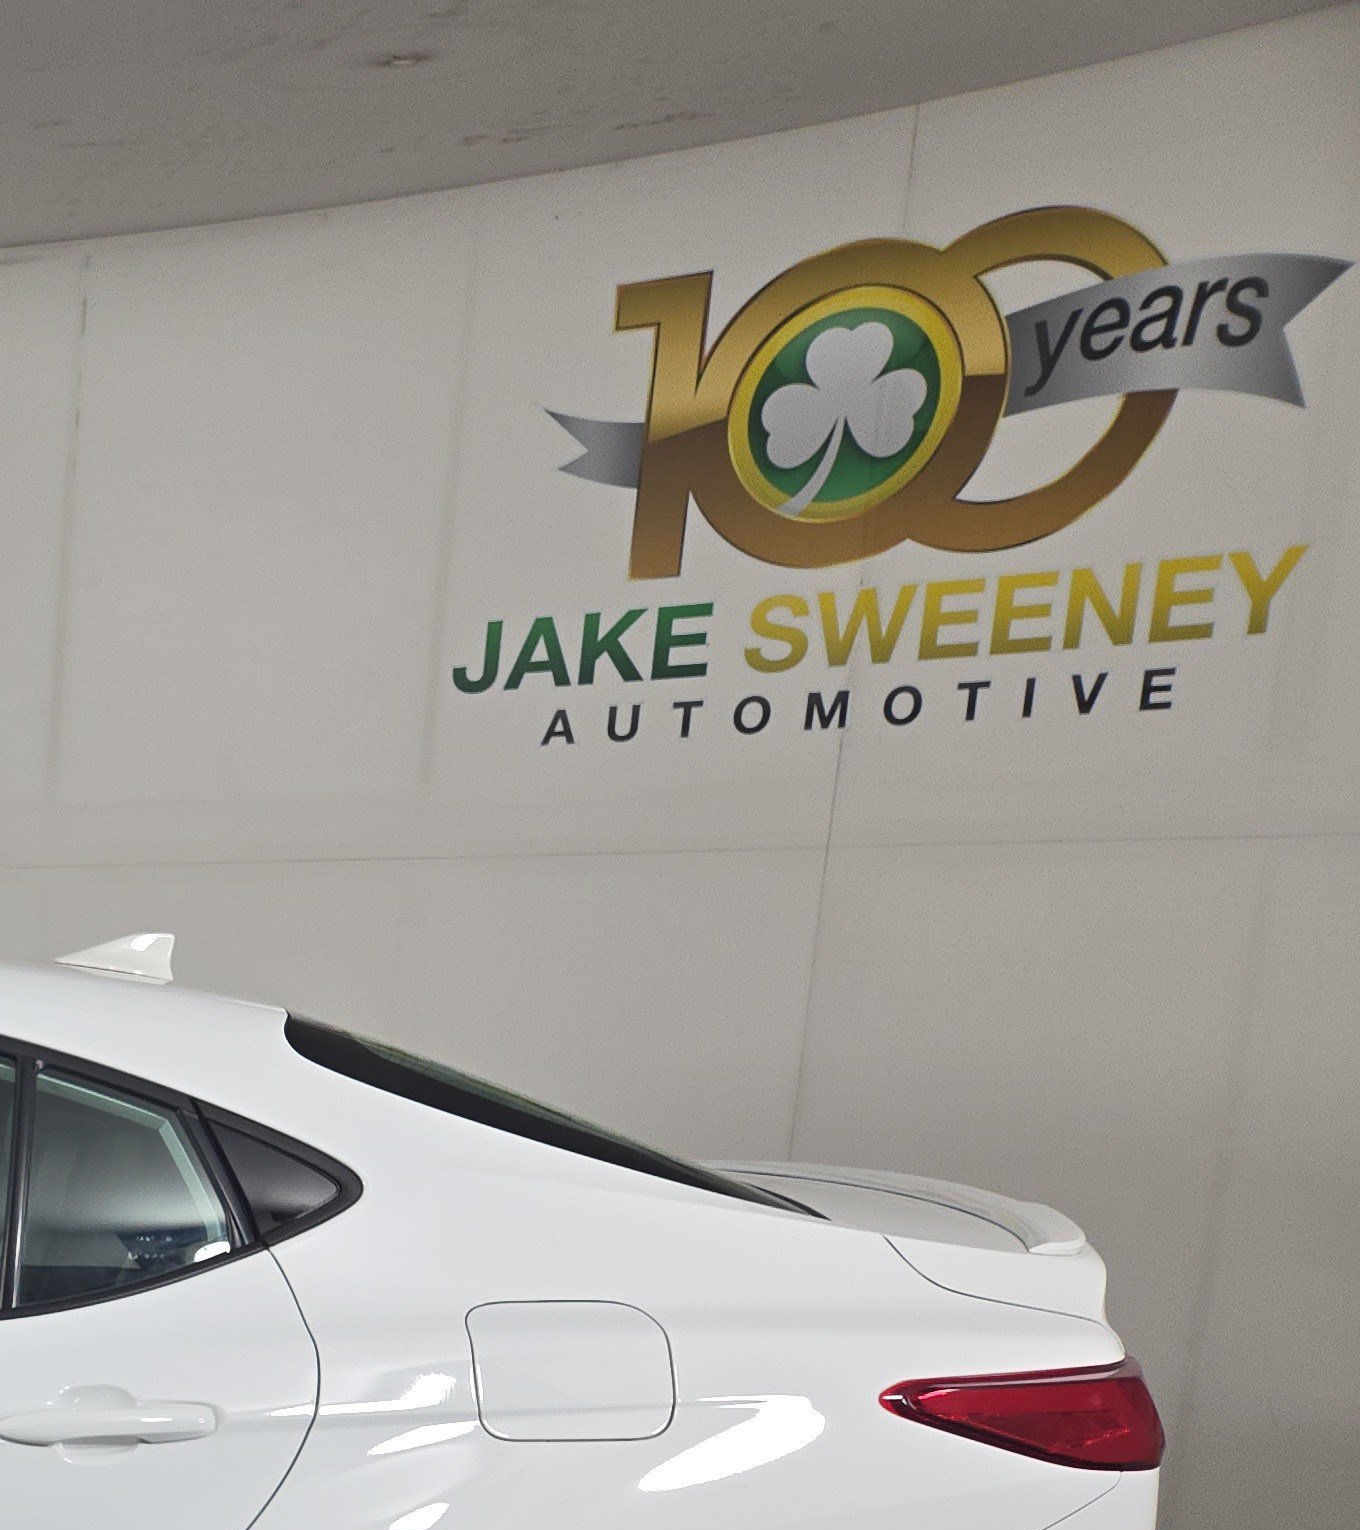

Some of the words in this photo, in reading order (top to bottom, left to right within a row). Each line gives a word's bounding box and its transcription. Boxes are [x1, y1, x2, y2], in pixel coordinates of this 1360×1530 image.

[613, 204, 1179, 581] 100
[1024, 275, 1269, 398] years
[451, 601, 714, 697] JAKE
[743, 545, 1311, 675] SWEENEY
[540, 667, 1179, 748] AUTOMOTIVE
